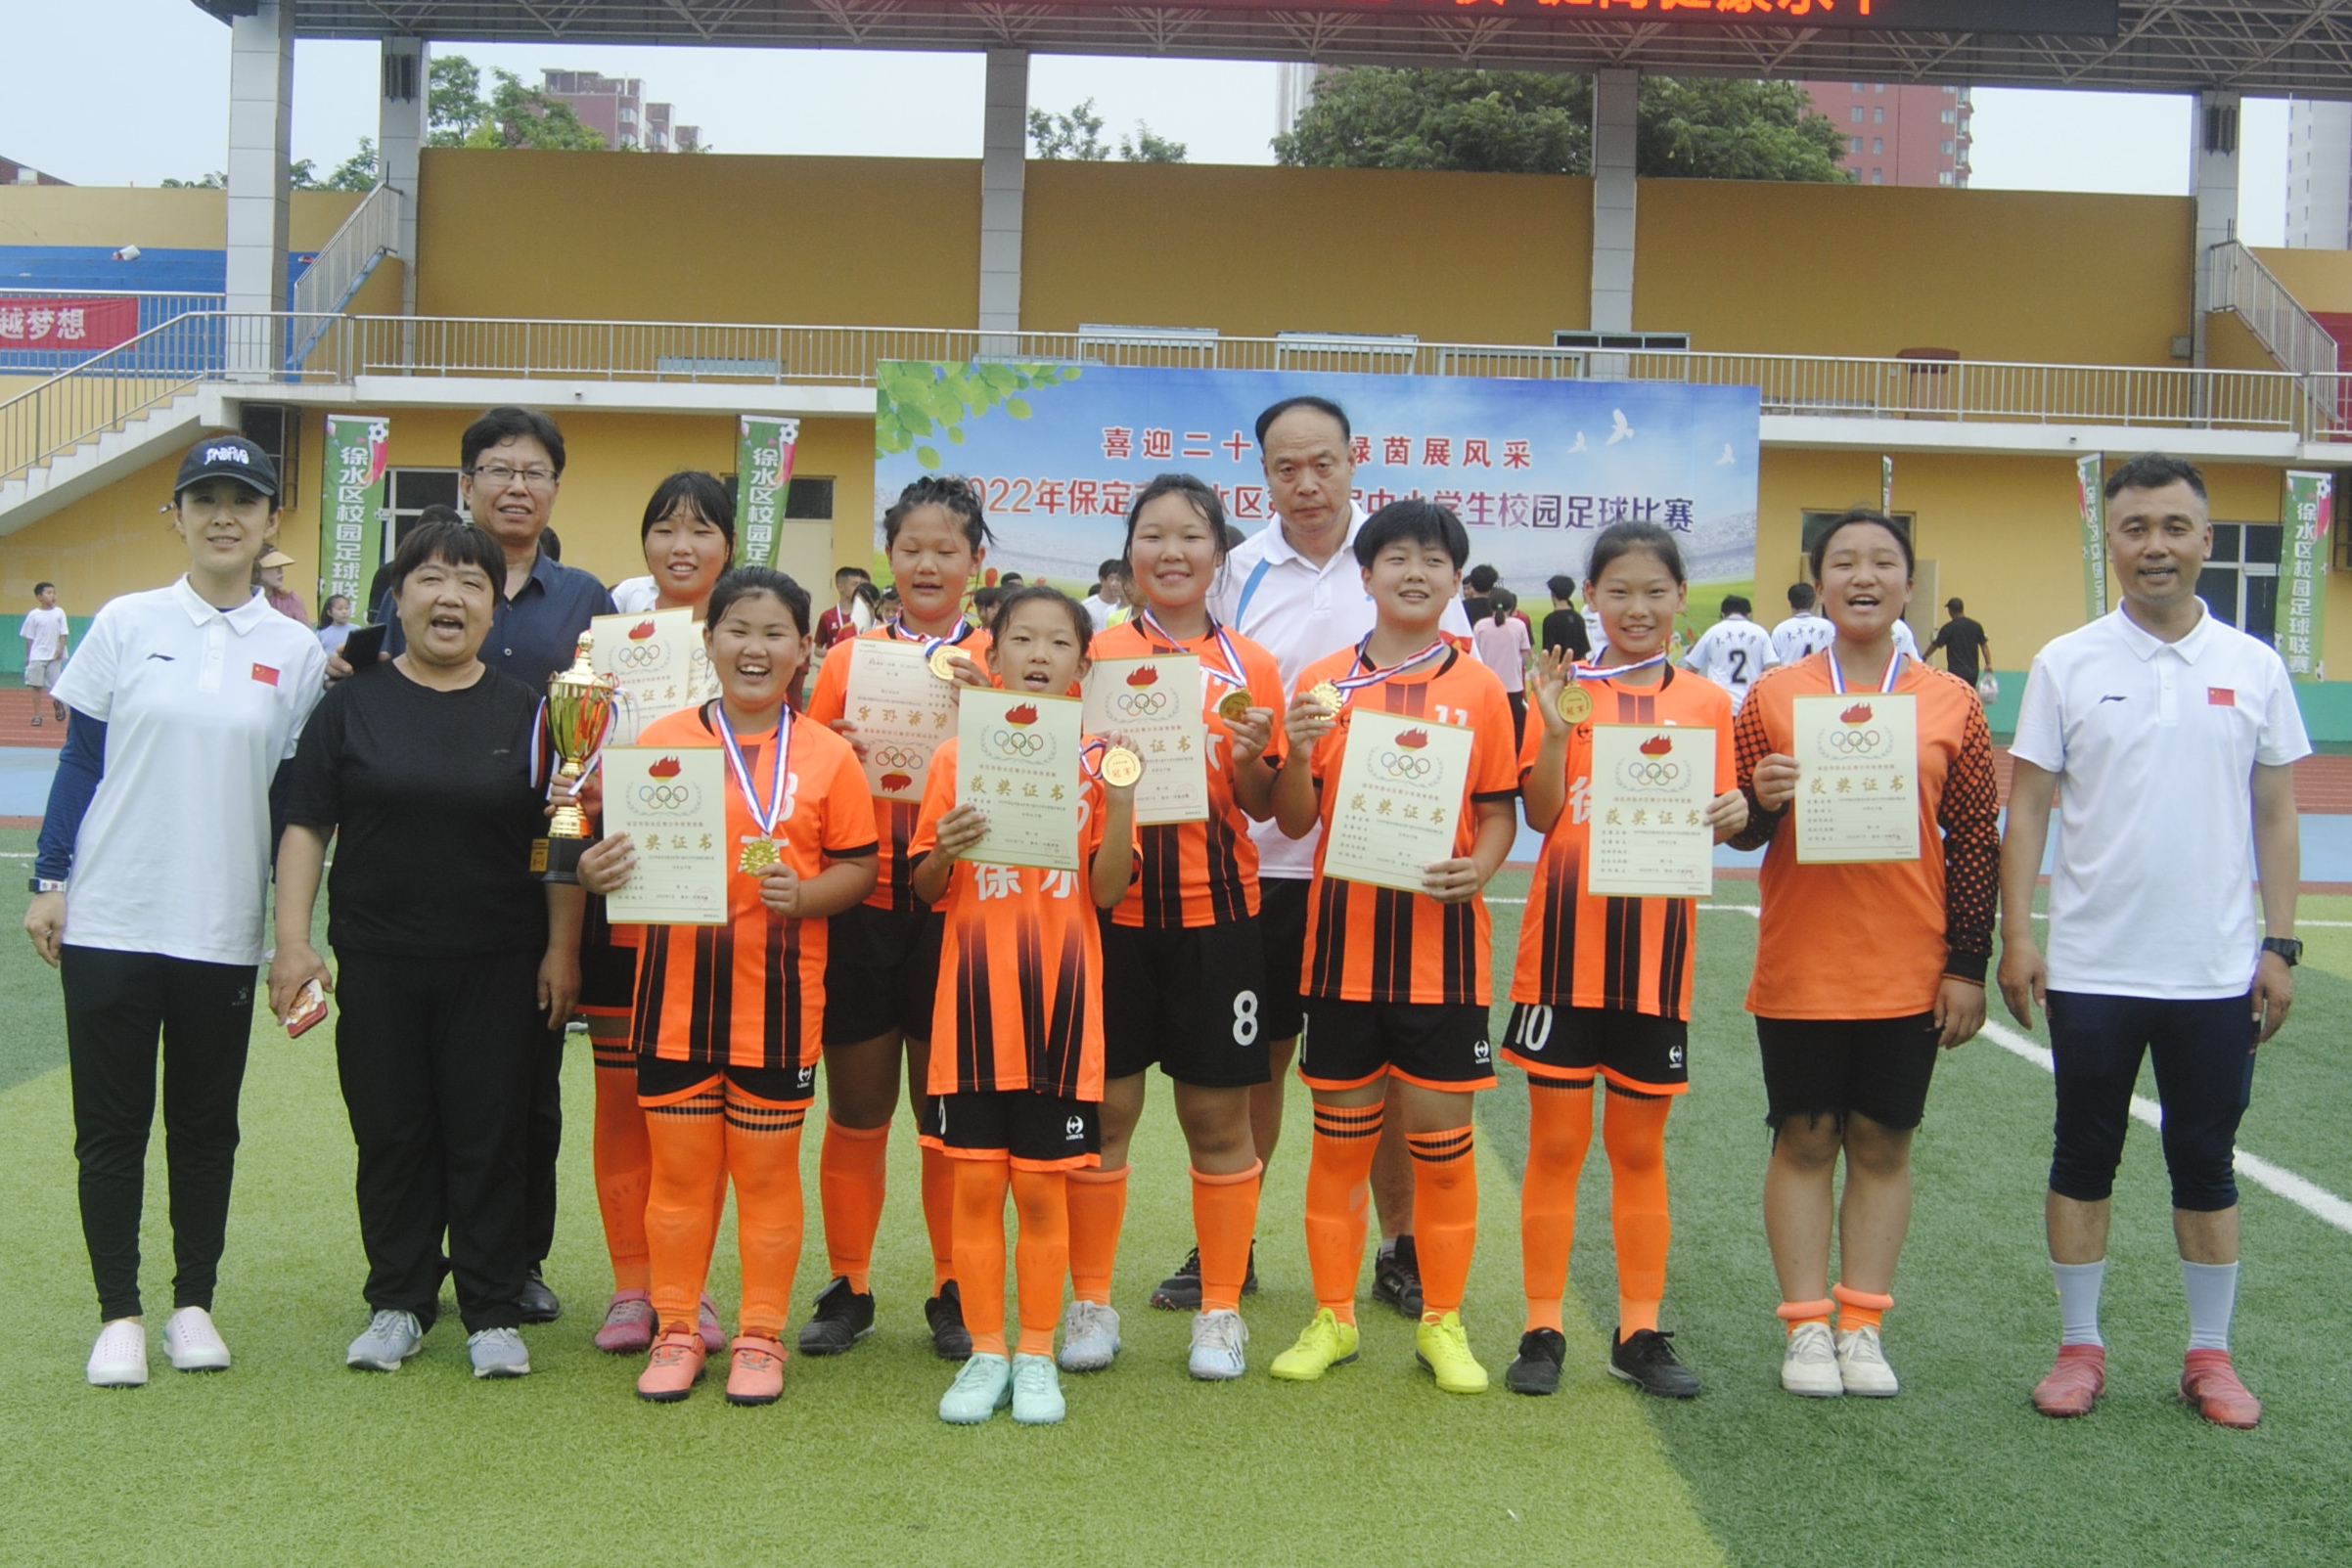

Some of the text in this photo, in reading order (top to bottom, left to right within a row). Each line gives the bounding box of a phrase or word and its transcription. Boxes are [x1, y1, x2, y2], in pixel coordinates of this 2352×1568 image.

[1103, 427, 1252, 461] 喜迎二十
[744, 447, 779, 567] 徐水区校园足
[330, 446, 369, 618] 徐水区校园足球联
[2288, 502, 2318, 674] 徐水区校园足球联赛
[1728, 649, 1748, 684] 2
[1150, 735, 1192, 753] 证书
[971, 775, 1065, 802] 获奖证书
[1810, 774, 1904, 794] 获奖证书
[1351, 793, 1446, 825] 获奖证书
[1606, 807, 1700, 827] 获奖证书
[1233, 989, 1258, 1047] 8
[1515, 1004, 1553, 1052] 10
